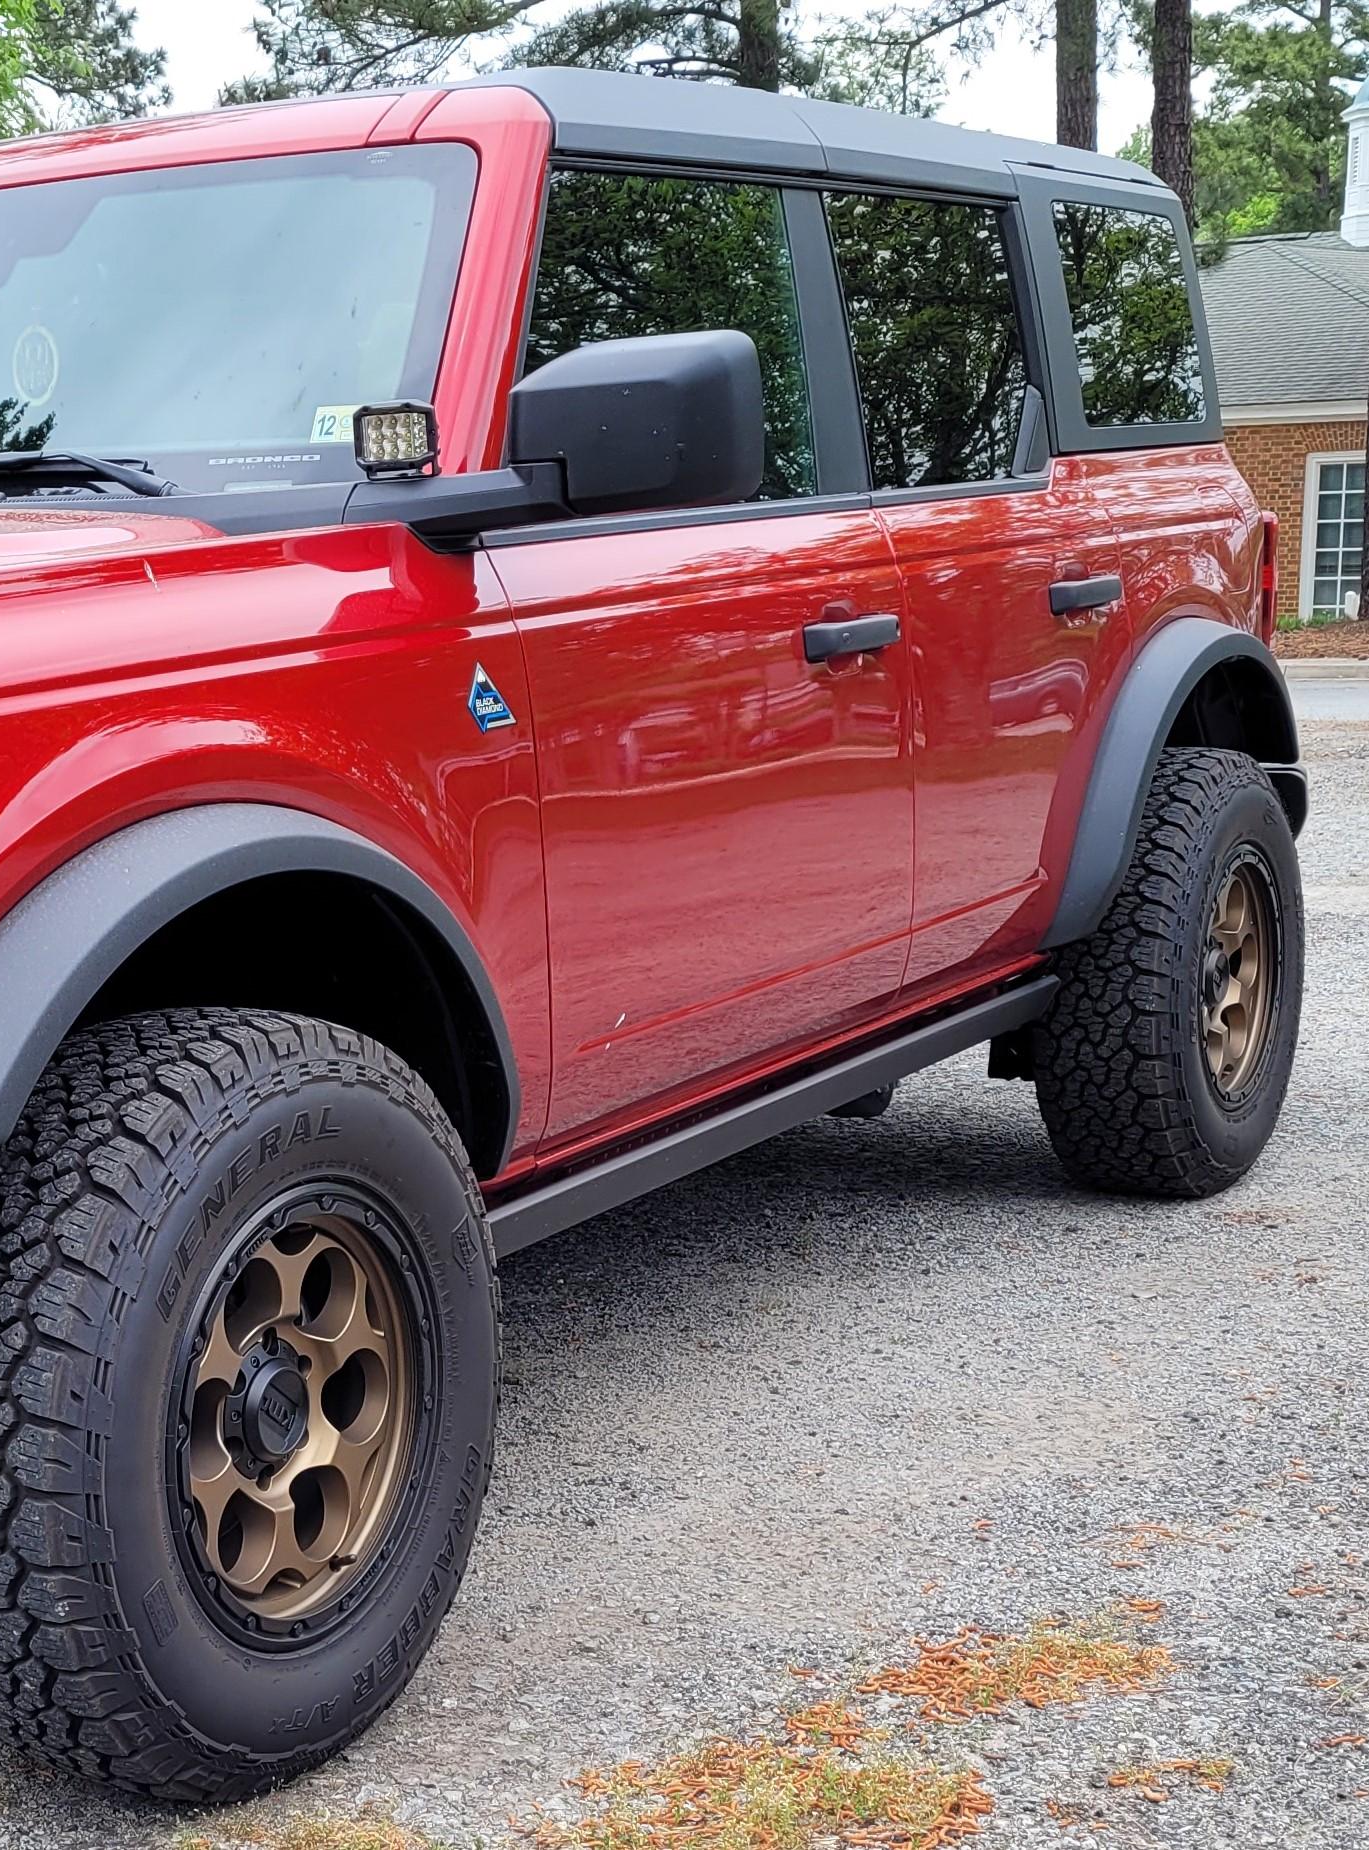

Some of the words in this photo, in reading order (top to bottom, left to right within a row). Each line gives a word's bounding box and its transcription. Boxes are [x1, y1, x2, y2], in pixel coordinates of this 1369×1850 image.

[317, 414, 337, 437] 12
[208, 454, 321, 465] BRONCO
[475, 697, 494, 708] BLACK
[477, 703, 504, 715] DIAMOND
[156, 1105, 342, 1323] GENERAL
[351, 1442, 481, 1705] GRABBER
